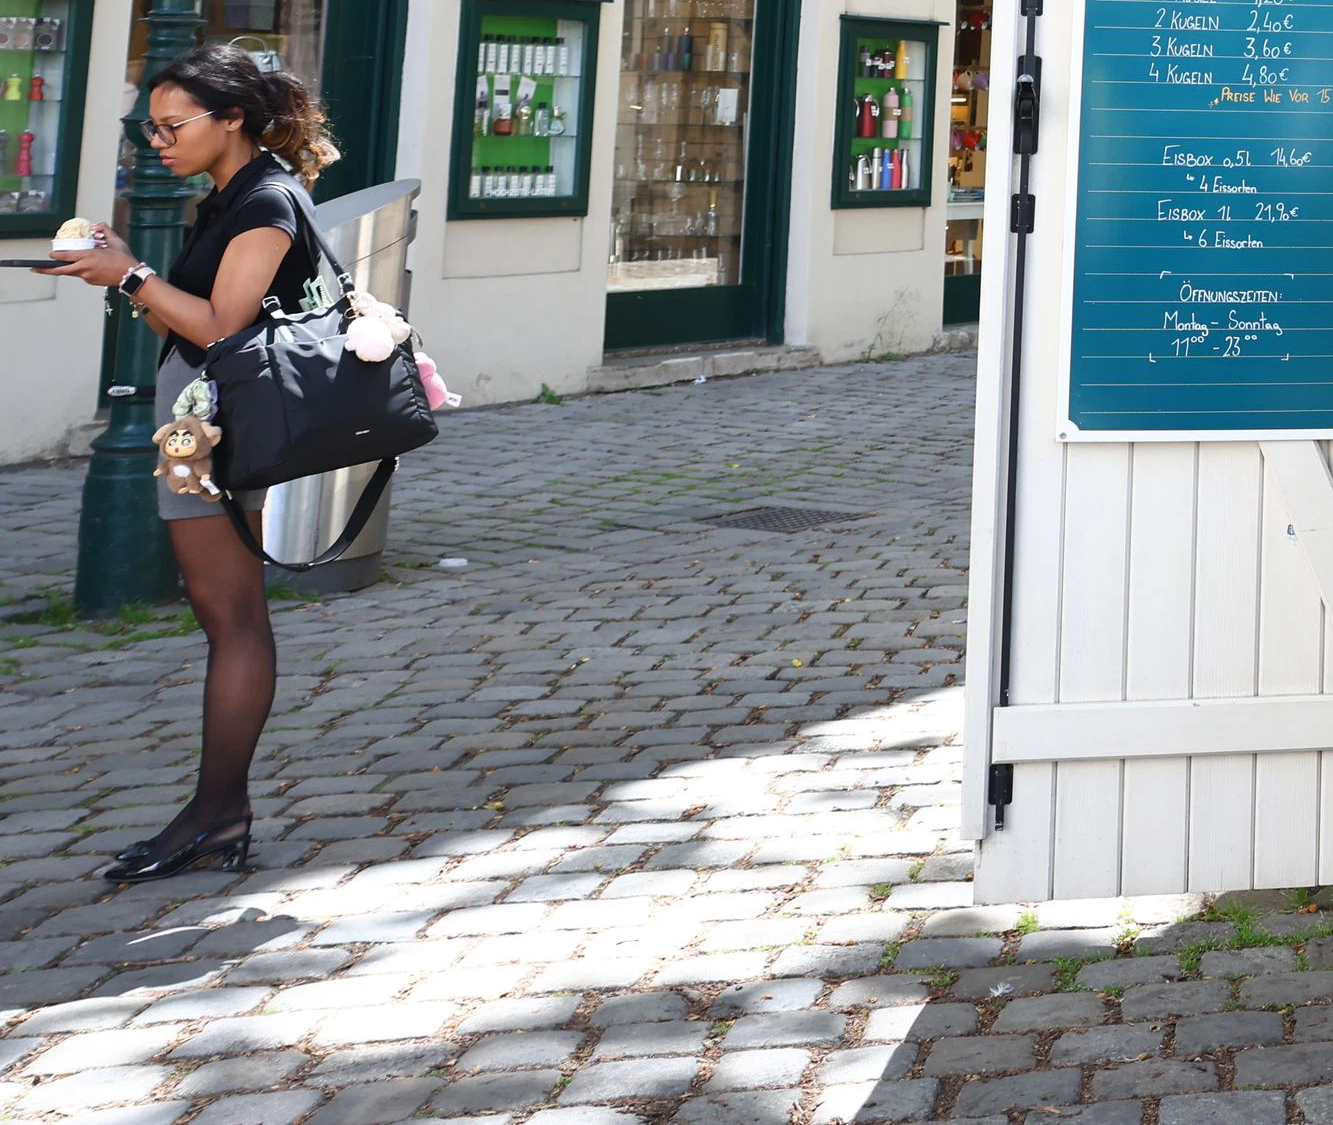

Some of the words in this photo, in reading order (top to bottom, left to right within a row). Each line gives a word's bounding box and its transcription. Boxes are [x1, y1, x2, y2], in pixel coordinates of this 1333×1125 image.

[1154, 8, 1163, 29] 2
[1247, 10, 1294, 34] 2,40€
[1150, 35, 1161, 57] 3
[1149, 62, 1159, 83] 4
[1241, 64, 1289, 88] 4,80€
[1316, 89, 1330, 103] 15
[1199, 176, 1208, 193] 4
[1212, 177, 1257, 194] Eissorten
[1198, 229, 1207, 248] 6
[1215, 231, 1263, 249] Eissorten
[1228, 310, 1283, 334] Sonntag
